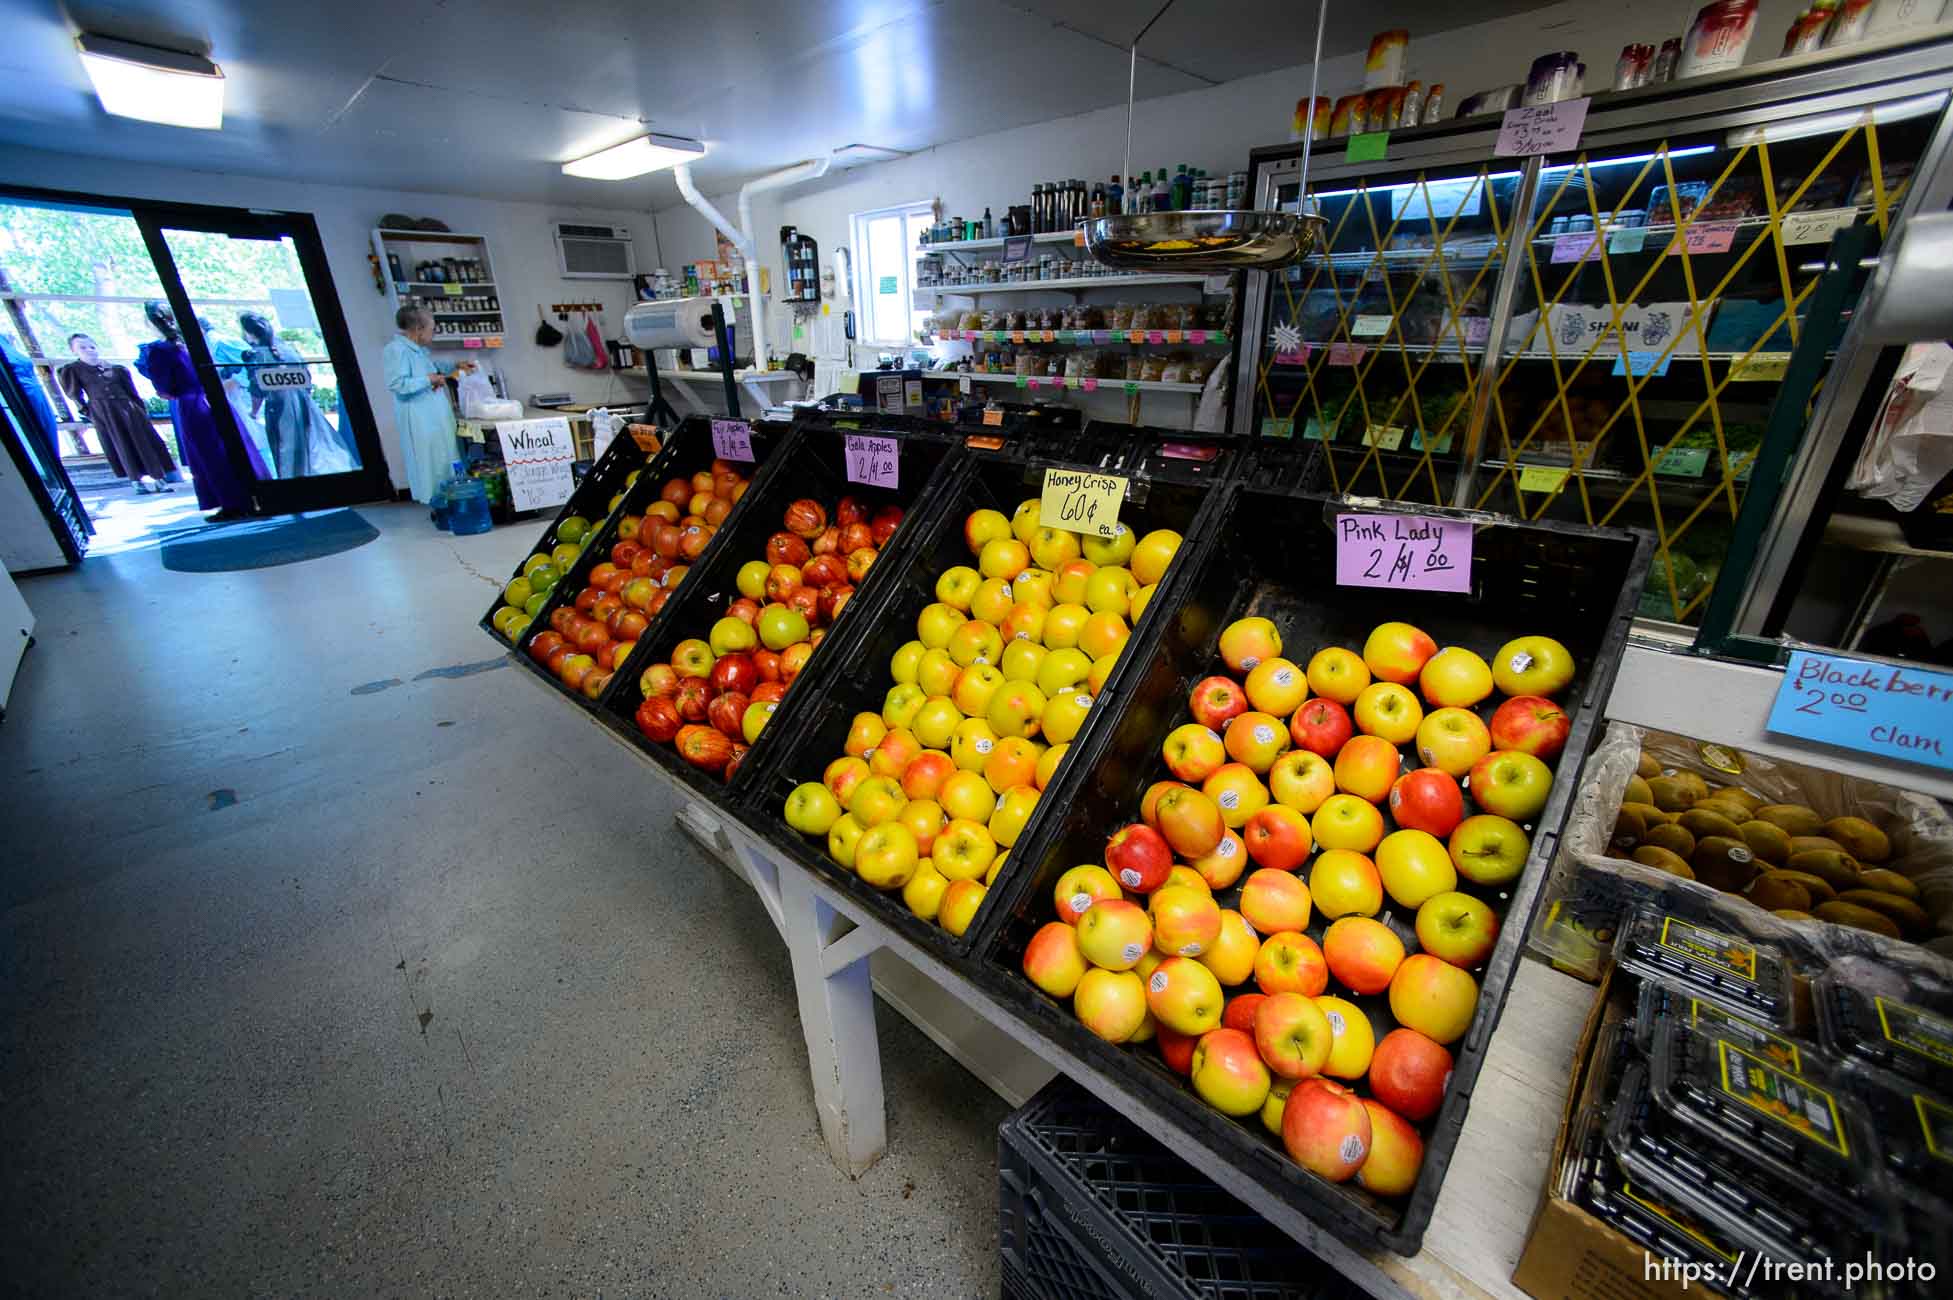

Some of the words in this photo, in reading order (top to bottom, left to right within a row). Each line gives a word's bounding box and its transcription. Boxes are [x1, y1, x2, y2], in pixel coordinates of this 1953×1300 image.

[1588, 321, 1640, 332] SHNI
[262, 372, 306, 386] CLOSED
[848, 436, 865, 451] Gala
[868, 440, 893, 457] Apples
[1047, 471, 1081, 494] Honey
[1082, 474, 1117, 496] Crisp
[1060, 493, 1098, 525] 60¢
[1340, 518, 1386, 543] Pink
[1394, 519, 1443, 553] Lady
